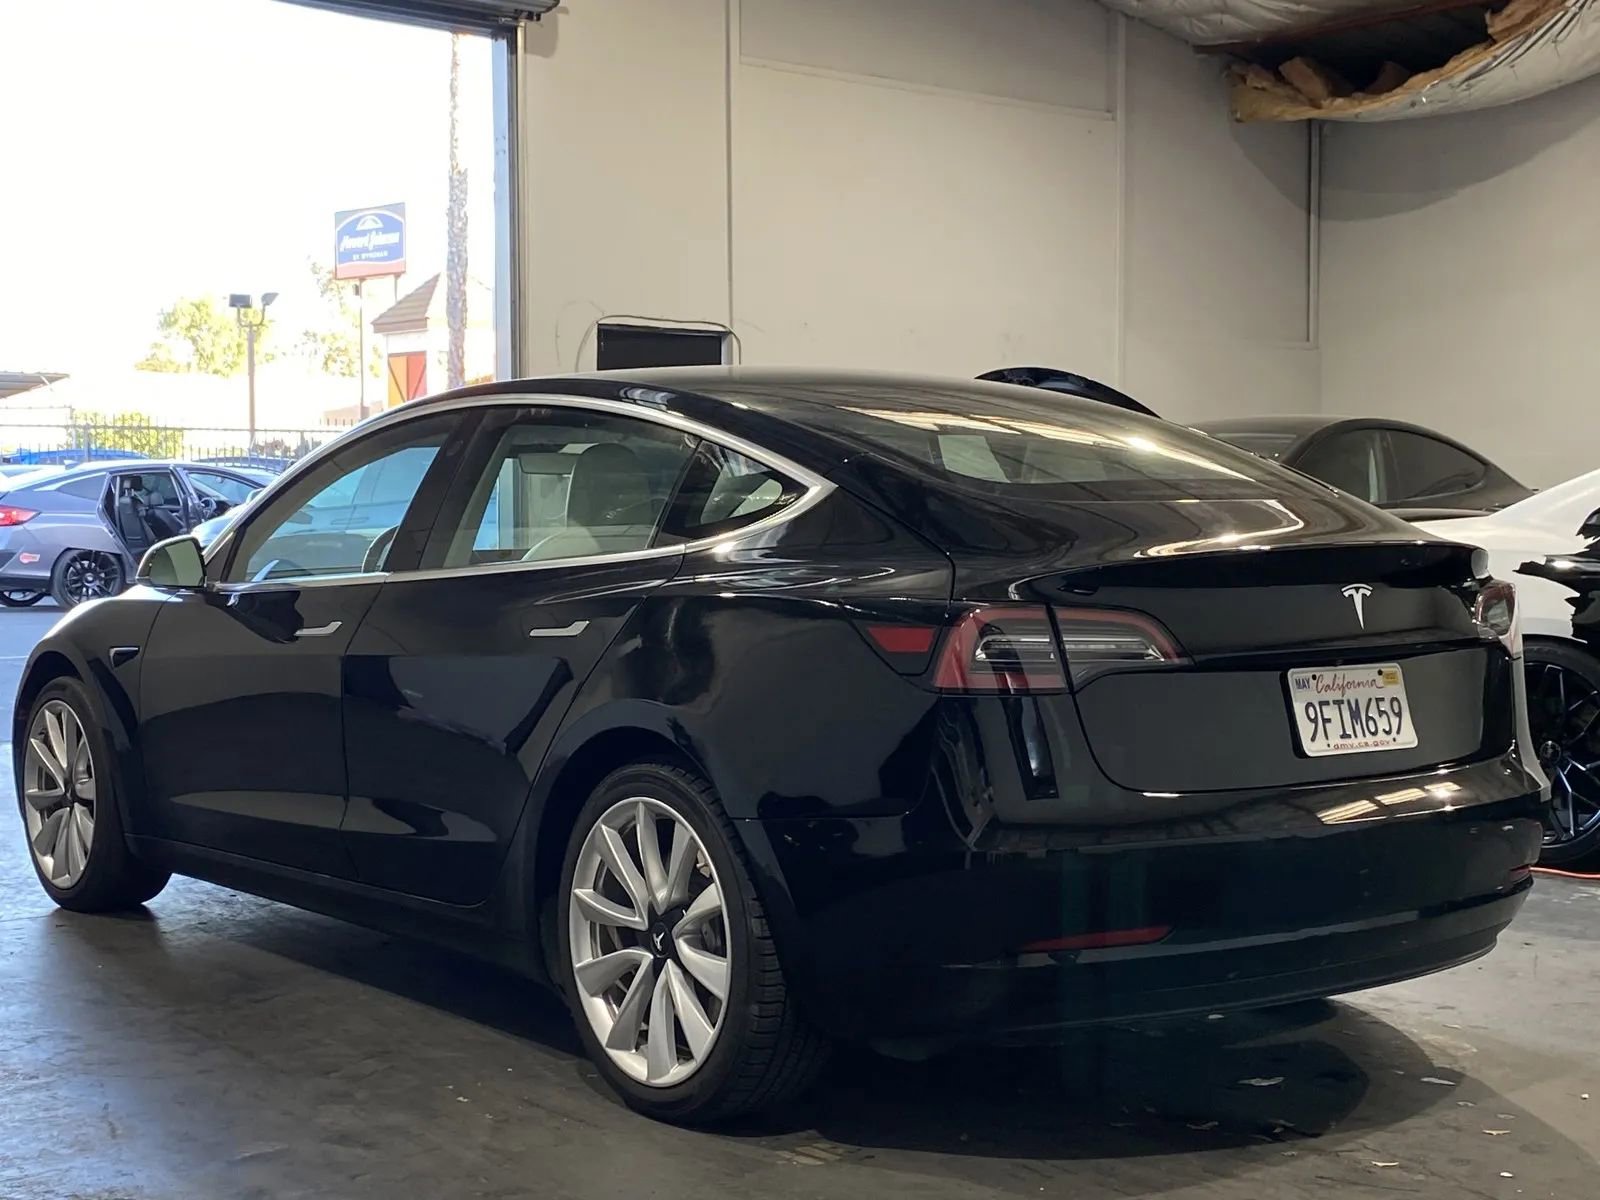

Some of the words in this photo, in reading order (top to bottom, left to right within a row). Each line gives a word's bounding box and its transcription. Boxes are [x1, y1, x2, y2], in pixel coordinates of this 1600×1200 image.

[1295, 678, 1311, 690] MAY
[1315, 674, 1384, 698] California
[1304, 696, 1403, 742] 9FIM659
